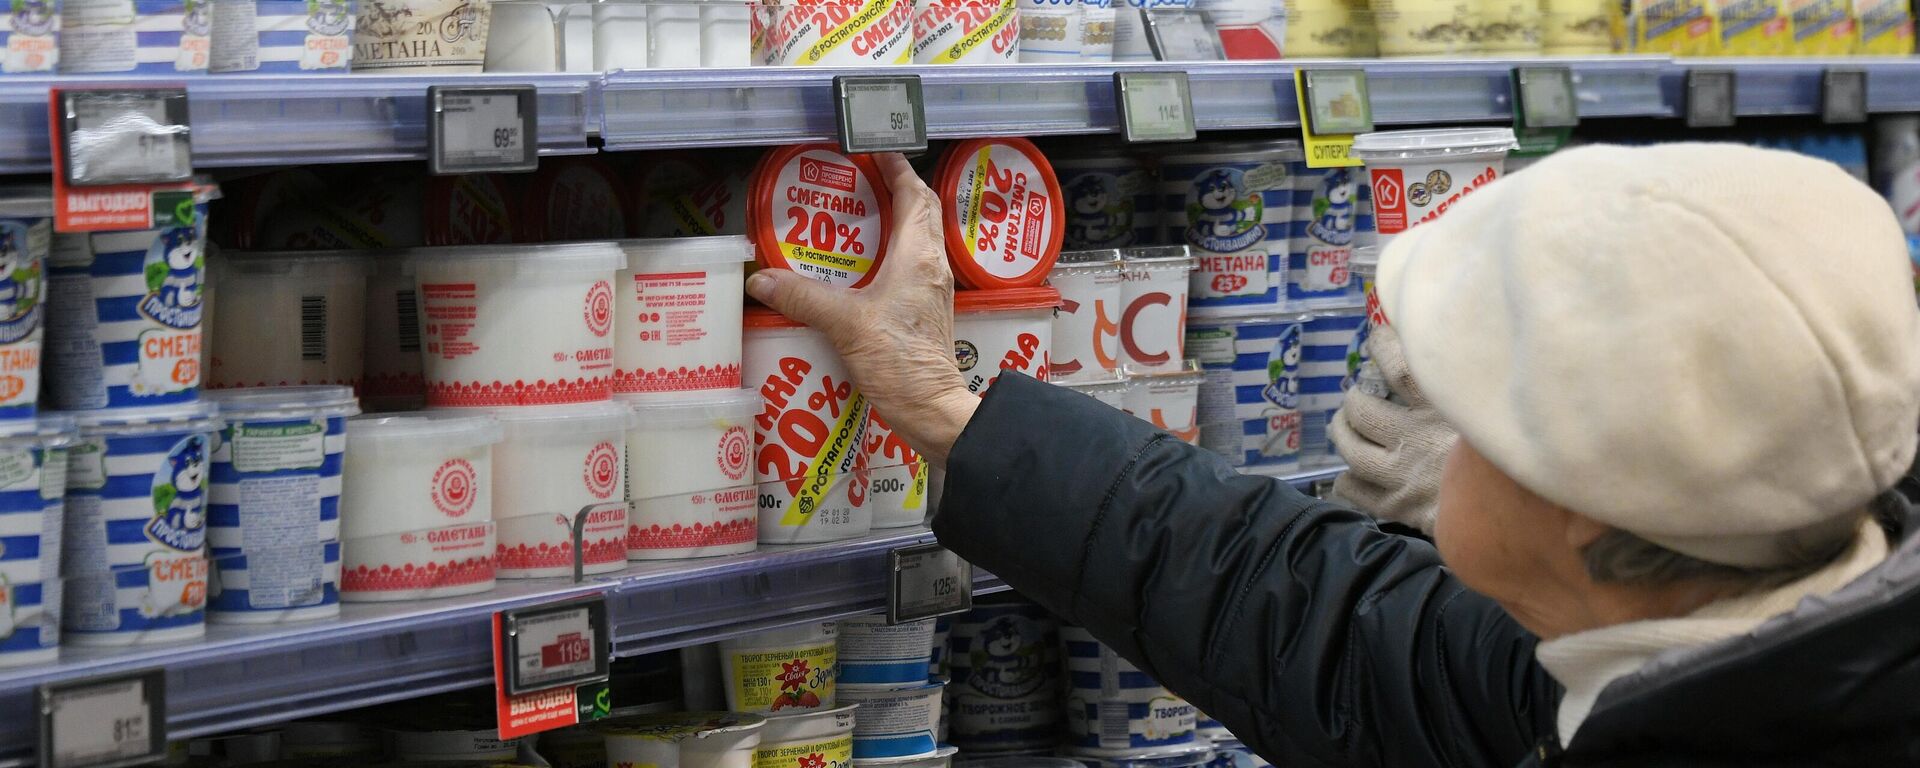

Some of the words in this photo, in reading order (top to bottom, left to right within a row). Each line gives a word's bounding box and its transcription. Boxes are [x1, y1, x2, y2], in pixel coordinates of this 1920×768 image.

[353, 40, 442, 60] МЕТАНА
[890, 112, 903, 130] 59
[493, 128, 510, 149] 69
[786, 185, 866, 217] СМЕТАНА
[977, 158, 1013, 252] 20%
[1003, 172, 1027, 263] СМЕТАНА
[785, 206, 865, 255] 20%
[799, 263, 814, 273] ГОСТ
[805, 250, 857, 268] РОСТАГРОЭКСПОРТ
[758, 375, 852, 498] 20%
[758, 493, 783, 509] 00г
[933, 577, 951, 596] 125
[558, 643, 582, 662] 119
[741, 653, 763, 663] ТВОРОГ
[757, 677, 767, 687] 130
